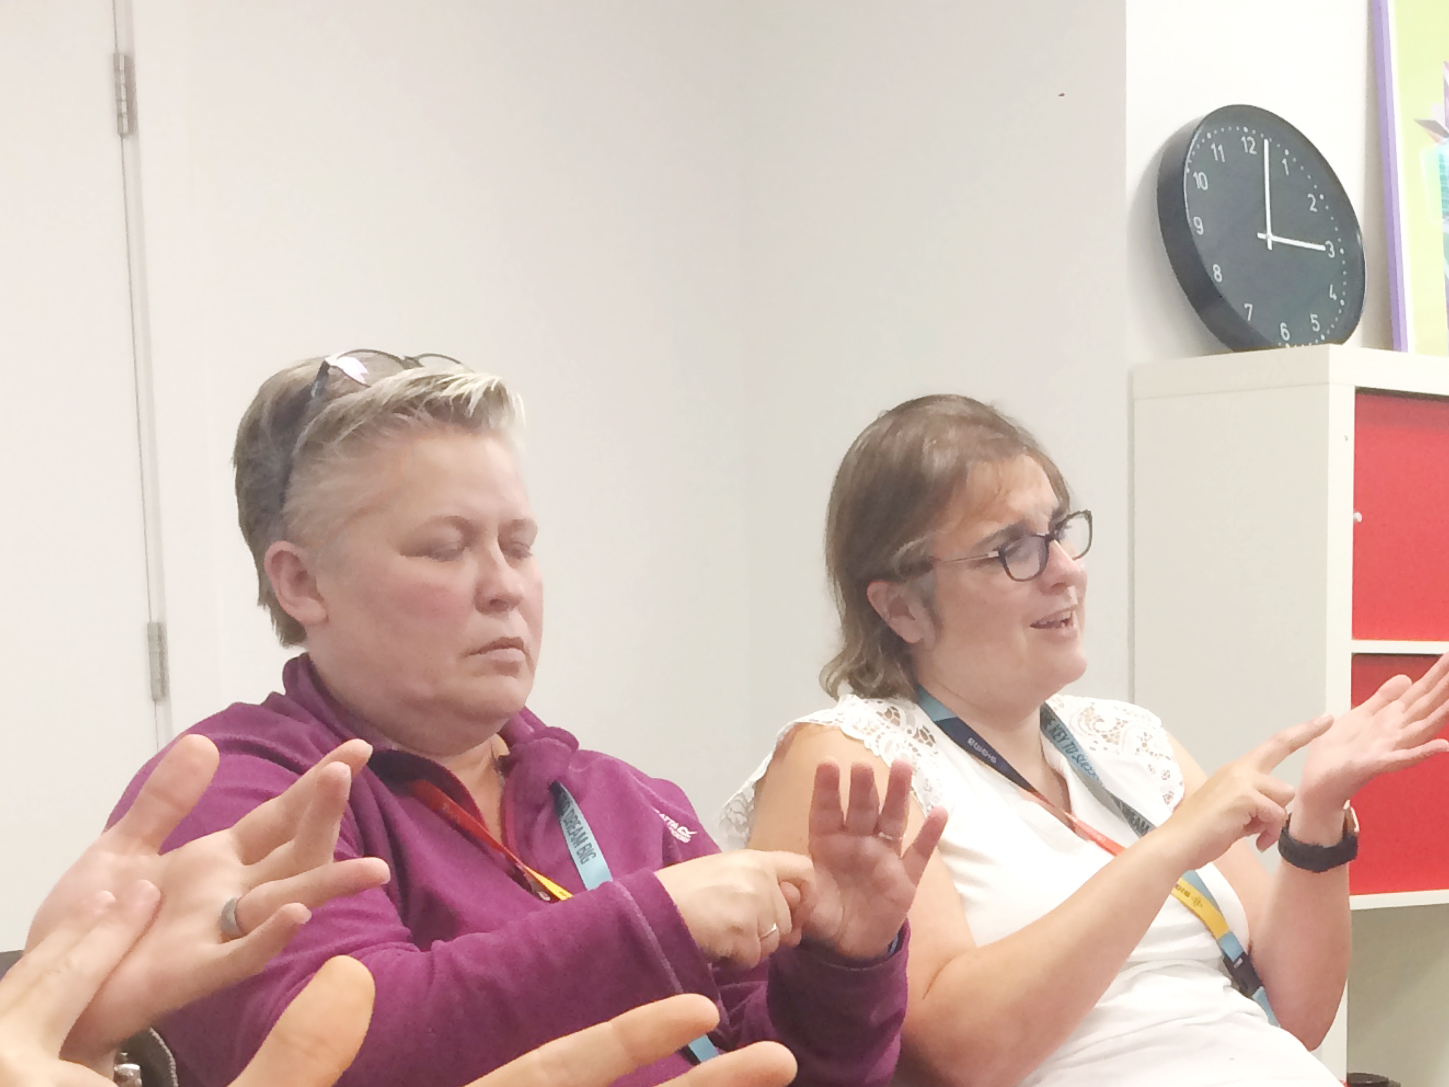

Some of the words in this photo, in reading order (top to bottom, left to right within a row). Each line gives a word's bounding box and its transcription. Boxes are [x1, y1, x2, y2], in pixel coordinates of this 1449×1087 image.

[1211, 143, 1226, 163] 11
[1241, 137, 1257, 155] 12
[1282, 158, 1290, 176] 1
[1193, 171, 1209, 190] 10
[1307, 193, 1318, 213] 2
[1193, 216, 1205, 236] 9
[1325, 240, 1336, 259] 3
[1212, 263, 1223, 283] 8
[1329, 284, 1337, 301] 4
[1244, 302, 1254, 321] 7
[1279, 322, 1291, 342] 6
[1309, 313, 1321, 333] 5
[1048, 724, 1070, 743] KEY
[1062, 741, 1079, 754] TO
[563, 808, 589, 849] DREAM
[576, 842, 597, 865] BIG
